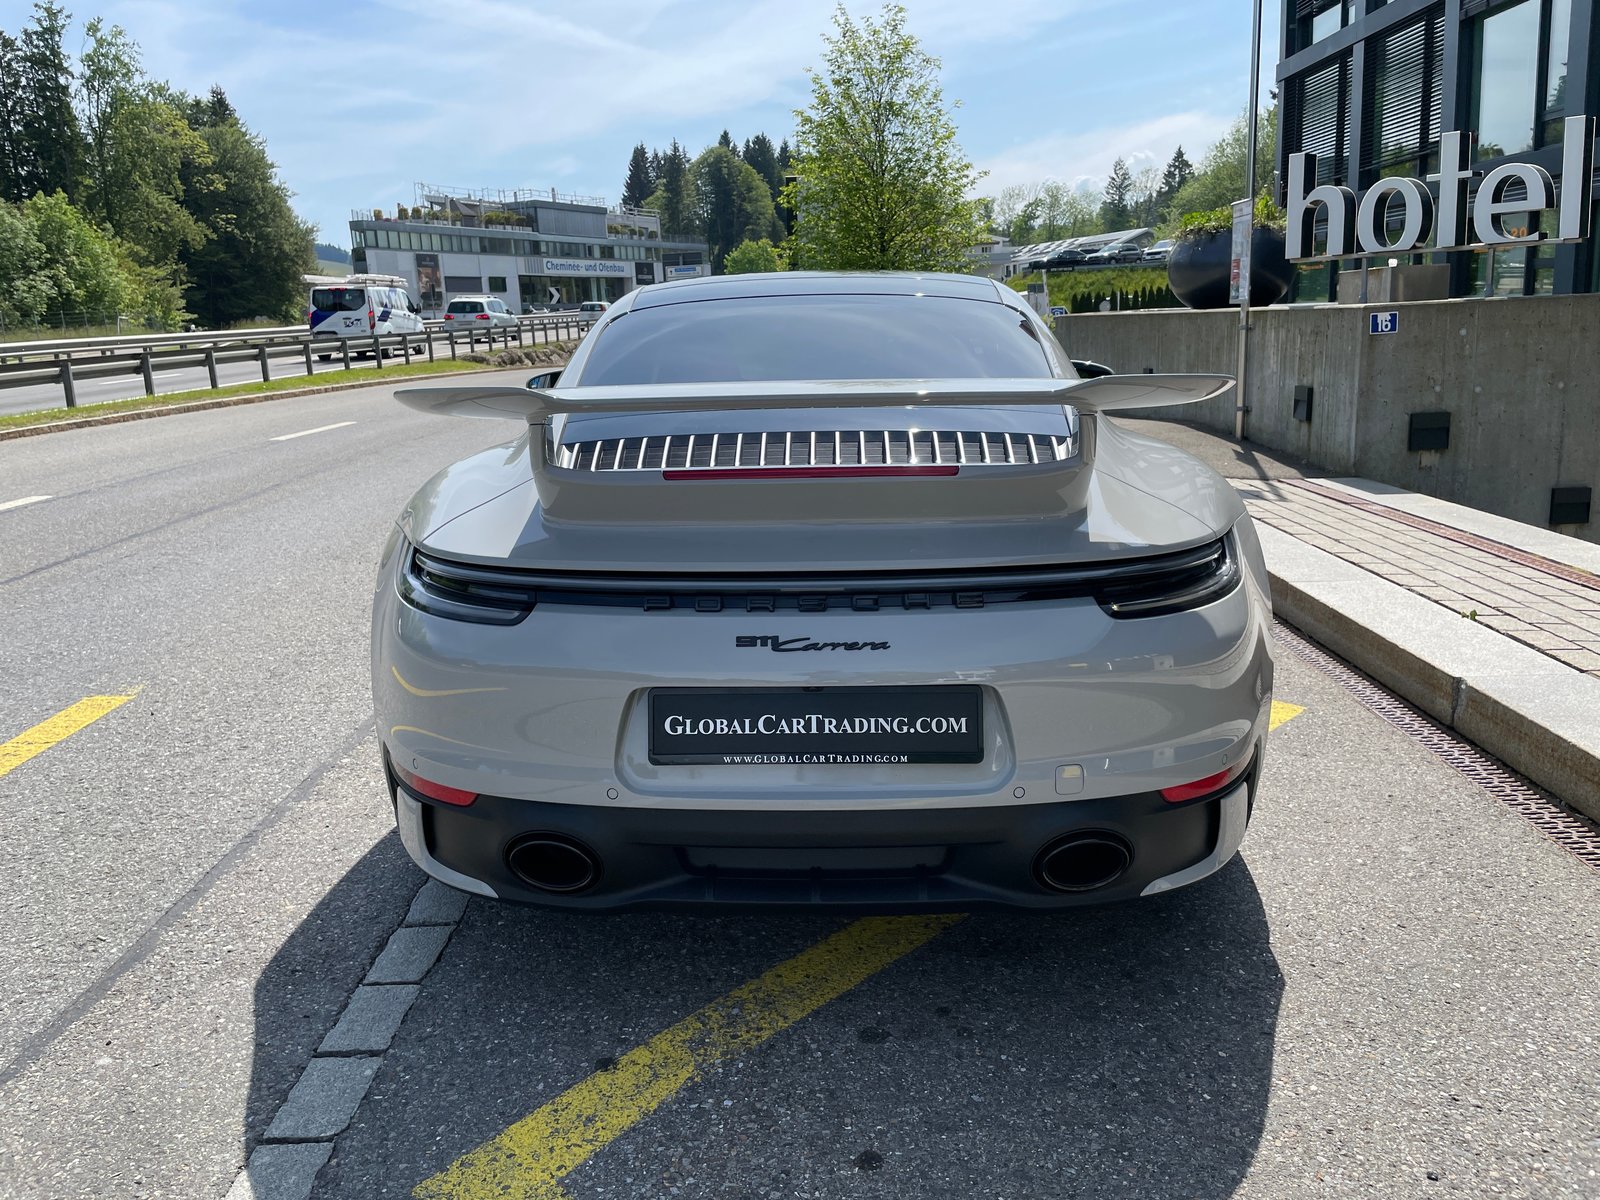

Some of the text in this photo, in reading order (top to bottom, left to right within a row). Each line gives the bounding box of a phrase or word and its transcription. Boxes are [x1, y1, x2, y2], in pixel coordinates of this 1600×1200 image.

[1285, 115, 1597, 260] hotel
[585, 262, 598, 272] und
[598, 262, 625, 273] Ofenbau
[1377, 313, 1392, 332] 16
[643, 592, 985, 613] PORSCHE
[735, 635, 891, 653] 911 Carrera
